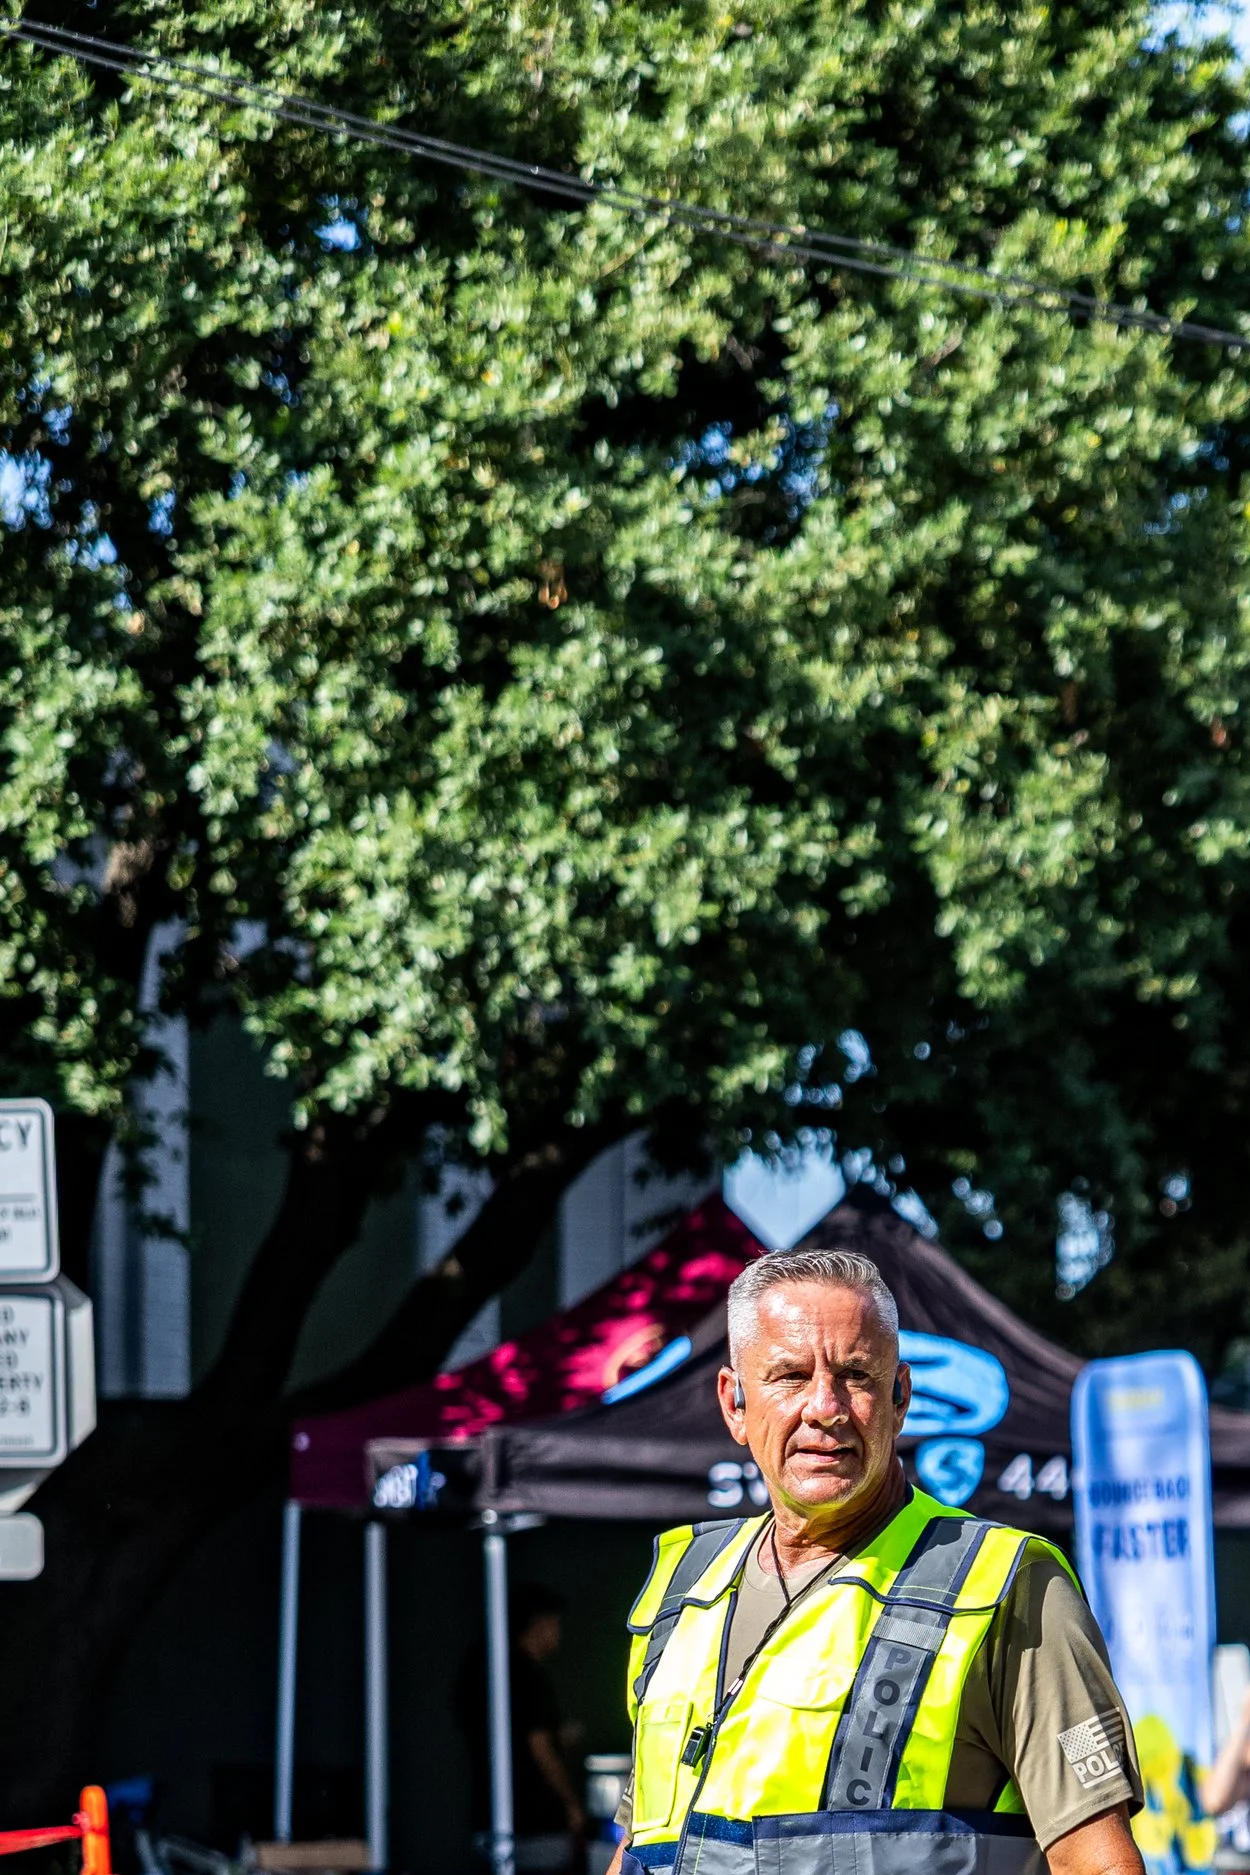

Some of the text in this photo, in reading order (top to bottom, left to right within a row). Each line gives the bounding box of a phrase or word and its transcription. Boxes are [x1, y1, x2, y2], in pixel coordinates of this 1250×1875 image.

[998, 1453, 1080, 1500] 44
[1092, 1517, 1190, 1562] FASTER
[846, 1647, 911, 1806] POLIC
